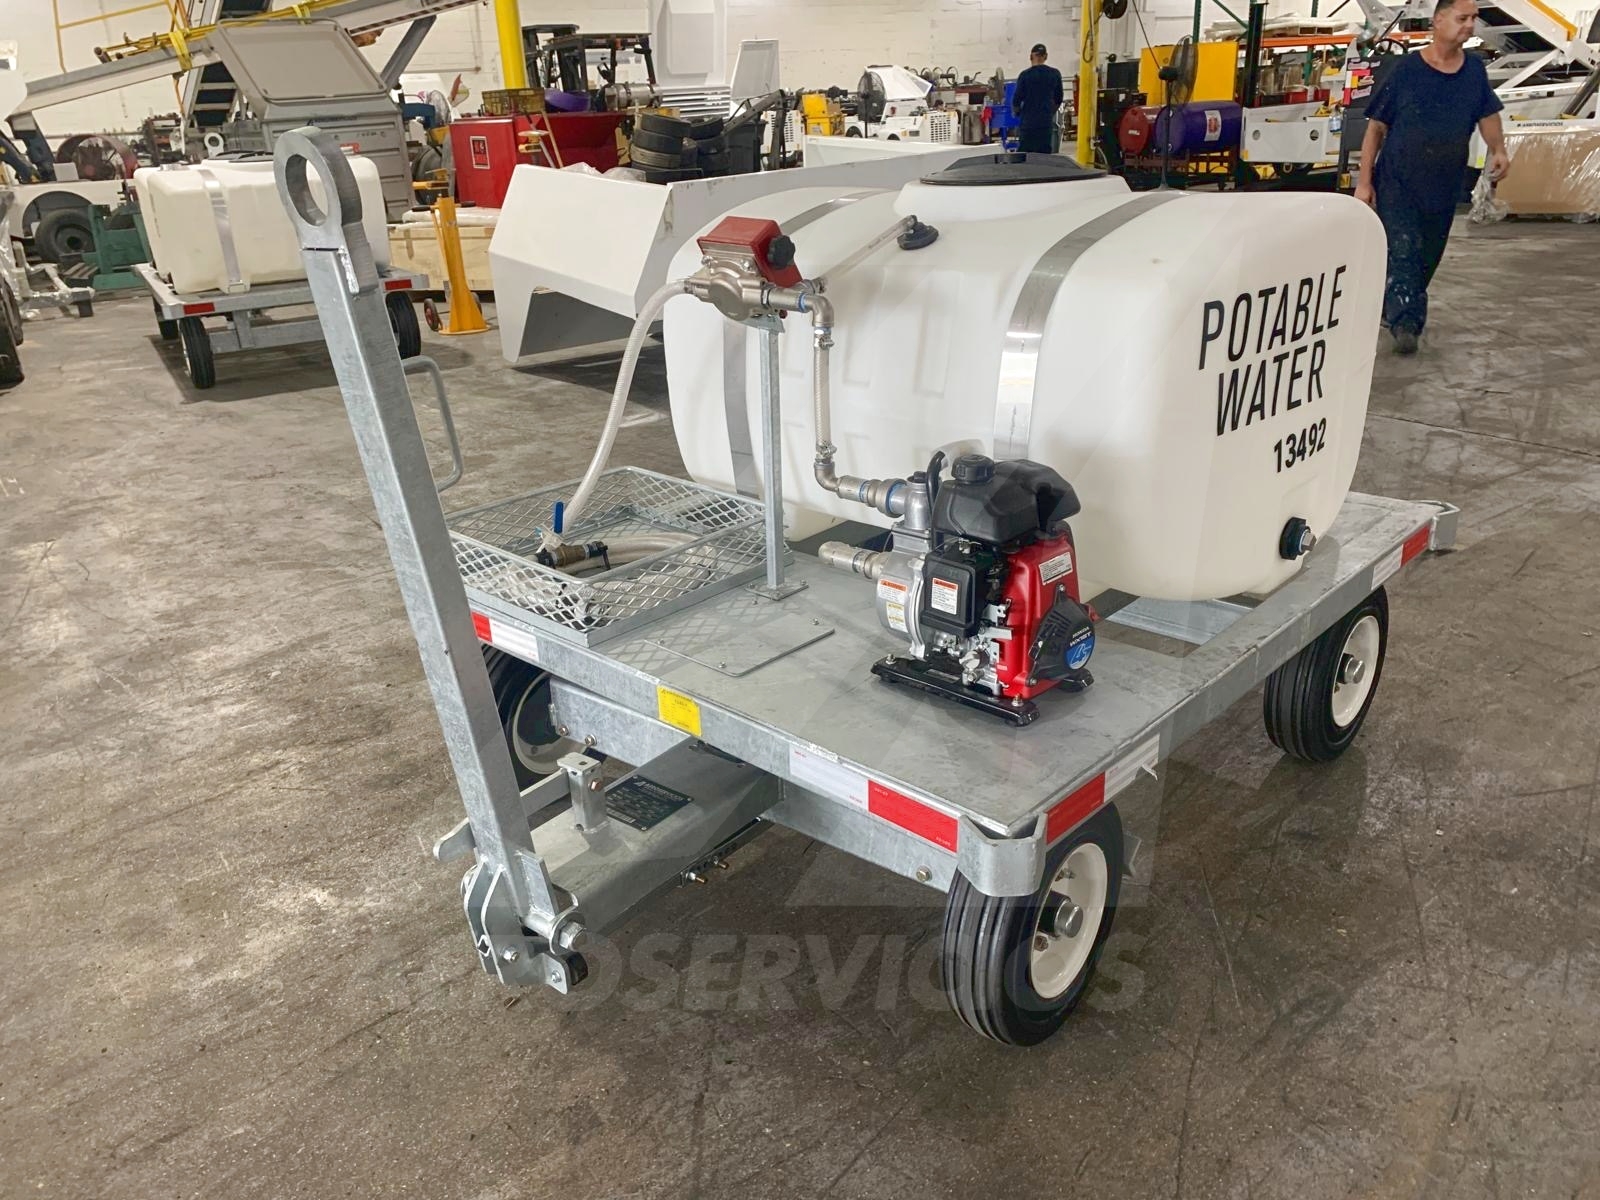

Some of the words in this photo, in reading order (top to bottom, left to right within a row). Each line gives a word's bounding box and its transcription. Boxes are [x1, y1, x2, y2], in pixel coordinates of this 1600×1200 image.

[1199, 265, 1347, 370] POTABLE
[1217, 339, 1326, 436] WATER
[1274, 418, 1327, 473] 13492
[1072, 626, 1090, 638] HONDA
